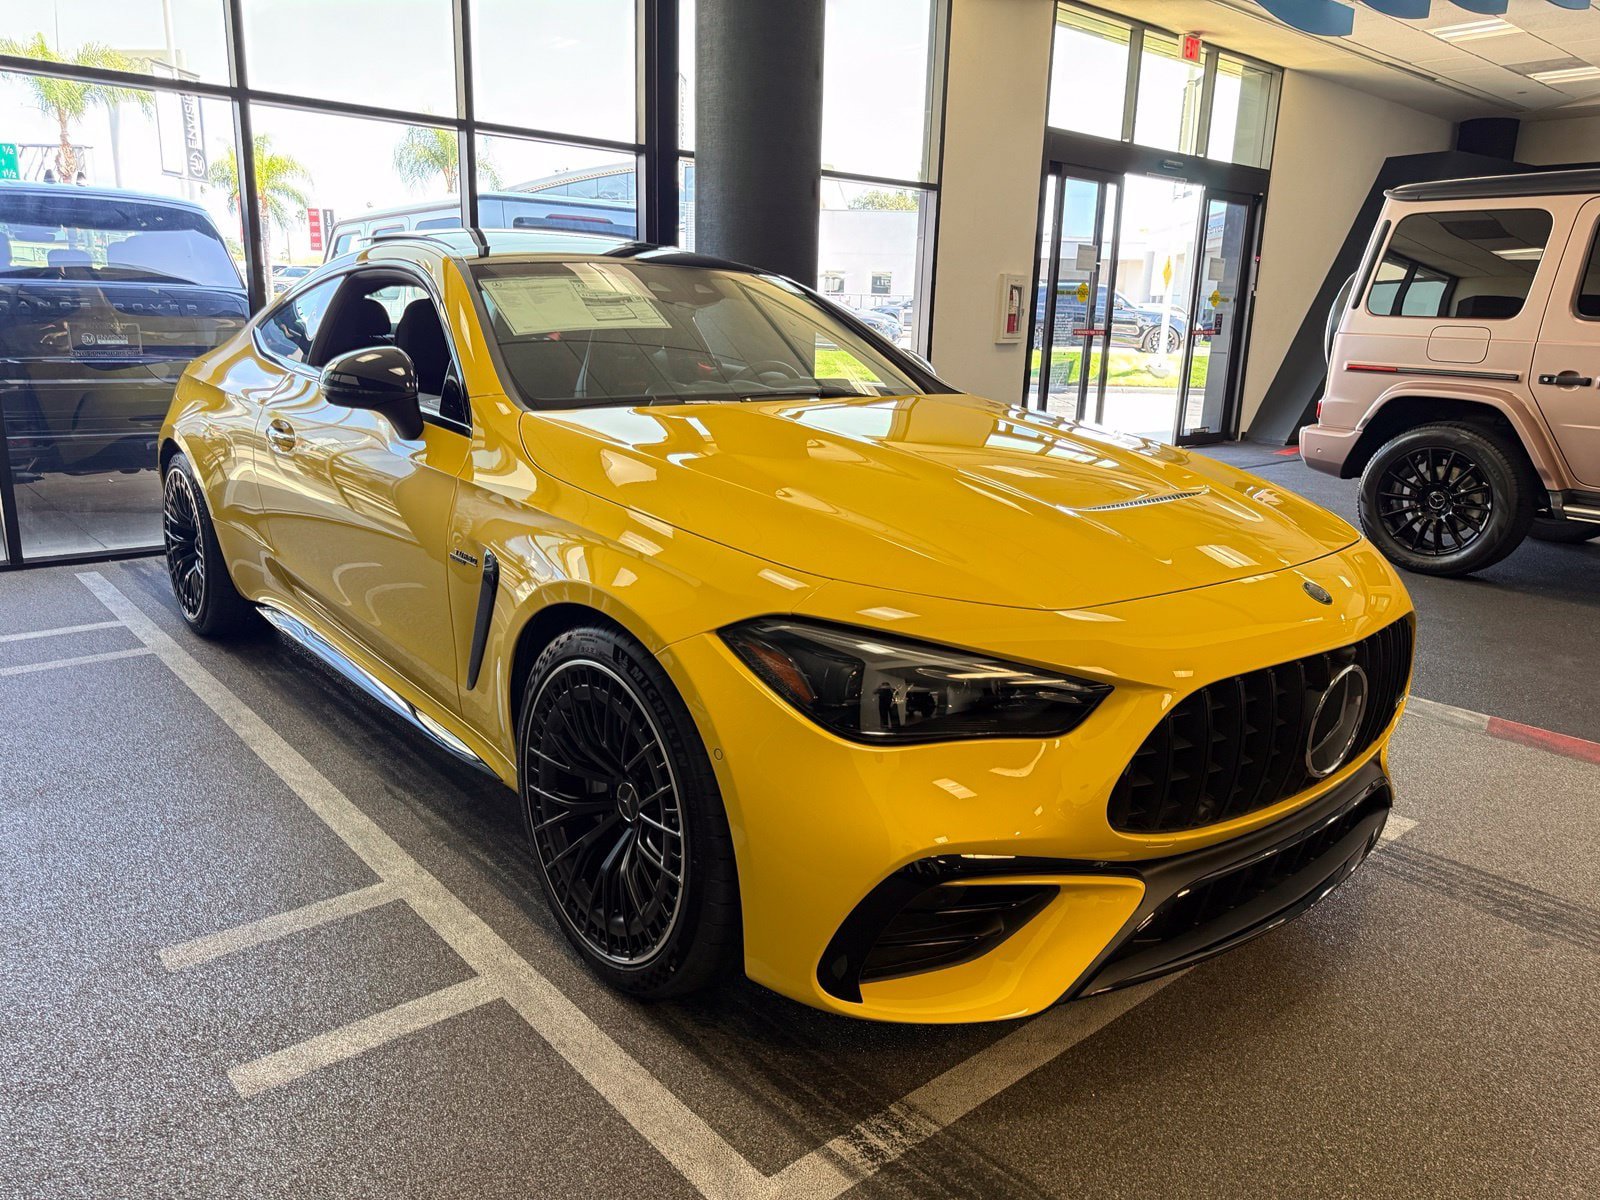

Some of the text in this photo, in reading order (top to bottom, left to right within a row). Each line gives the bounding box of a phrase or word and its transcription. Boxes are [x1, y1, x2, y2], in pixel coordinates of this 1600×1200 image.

[1185, 37, 1200, 61] EXIT
[183, 94, 198, 149] ENVISI
[112, 302, 198, 312] ROVER
[629, 665, 689, 768] MICHELIN
